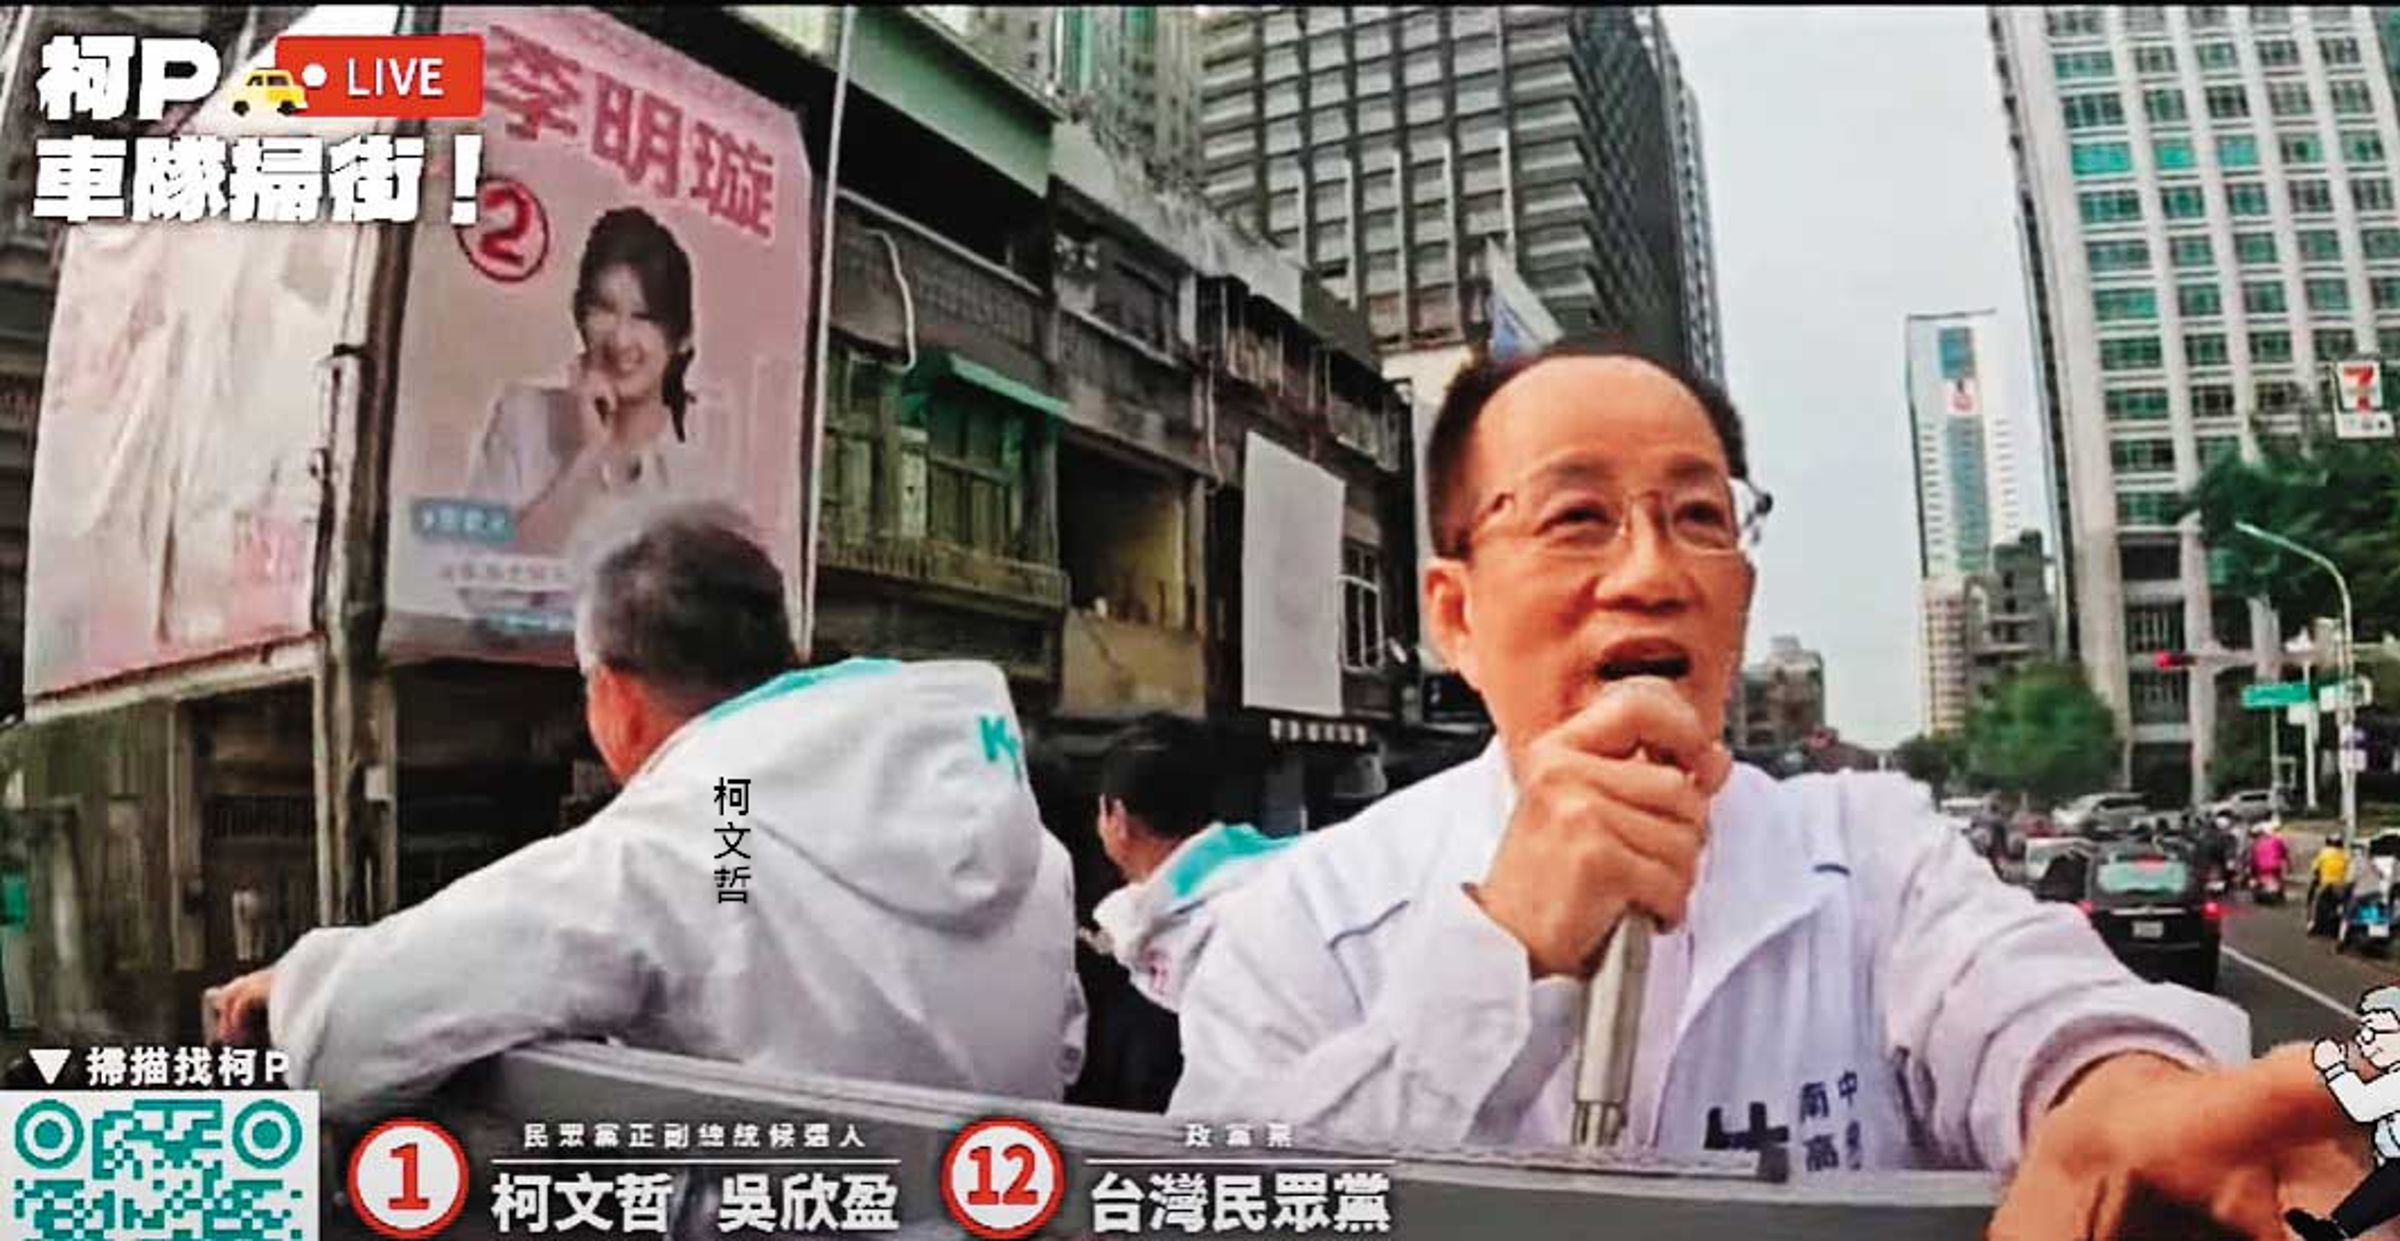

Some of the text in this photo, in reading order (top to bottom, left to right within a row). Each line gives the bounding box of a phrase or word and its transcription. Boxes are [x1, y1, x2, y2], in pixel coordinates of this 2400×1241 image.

[485, 25, 774, 238] 李明璇
[478, 186, 530, 268] 2
